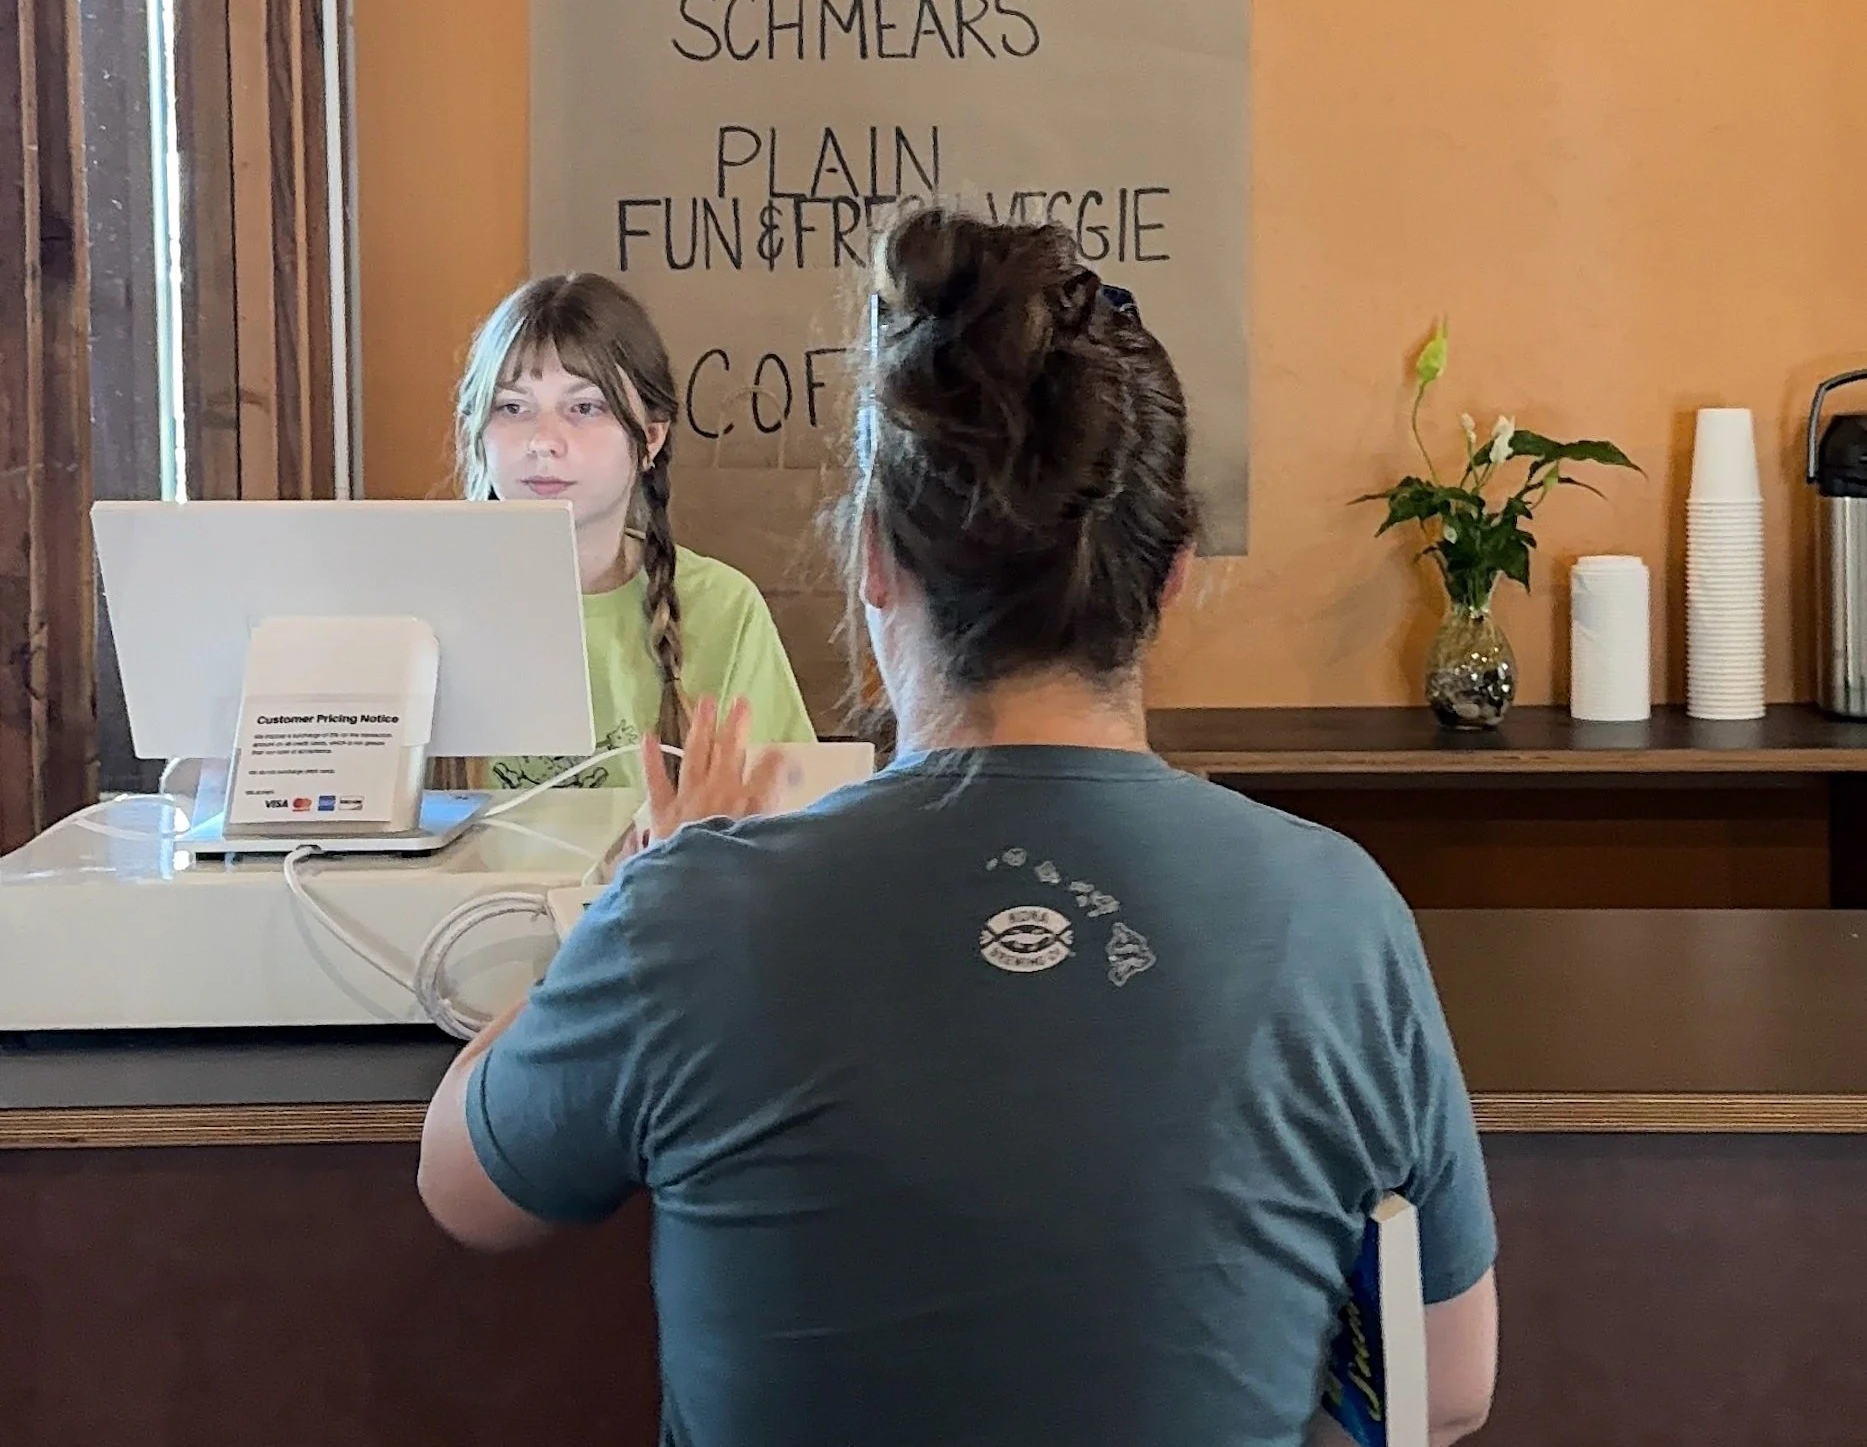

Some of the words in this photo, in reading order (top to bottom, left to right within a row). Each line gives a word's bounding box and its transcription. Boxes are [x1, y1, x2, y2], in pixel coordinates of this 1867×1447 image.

[716, 124, 940, 199] PLAIN
[256, 714, 314, 725] Customer
[316, 713, 358, 725] Pricing
[360, 714, 399, 724] Notice
[265, 800, 288, 808] VISA
